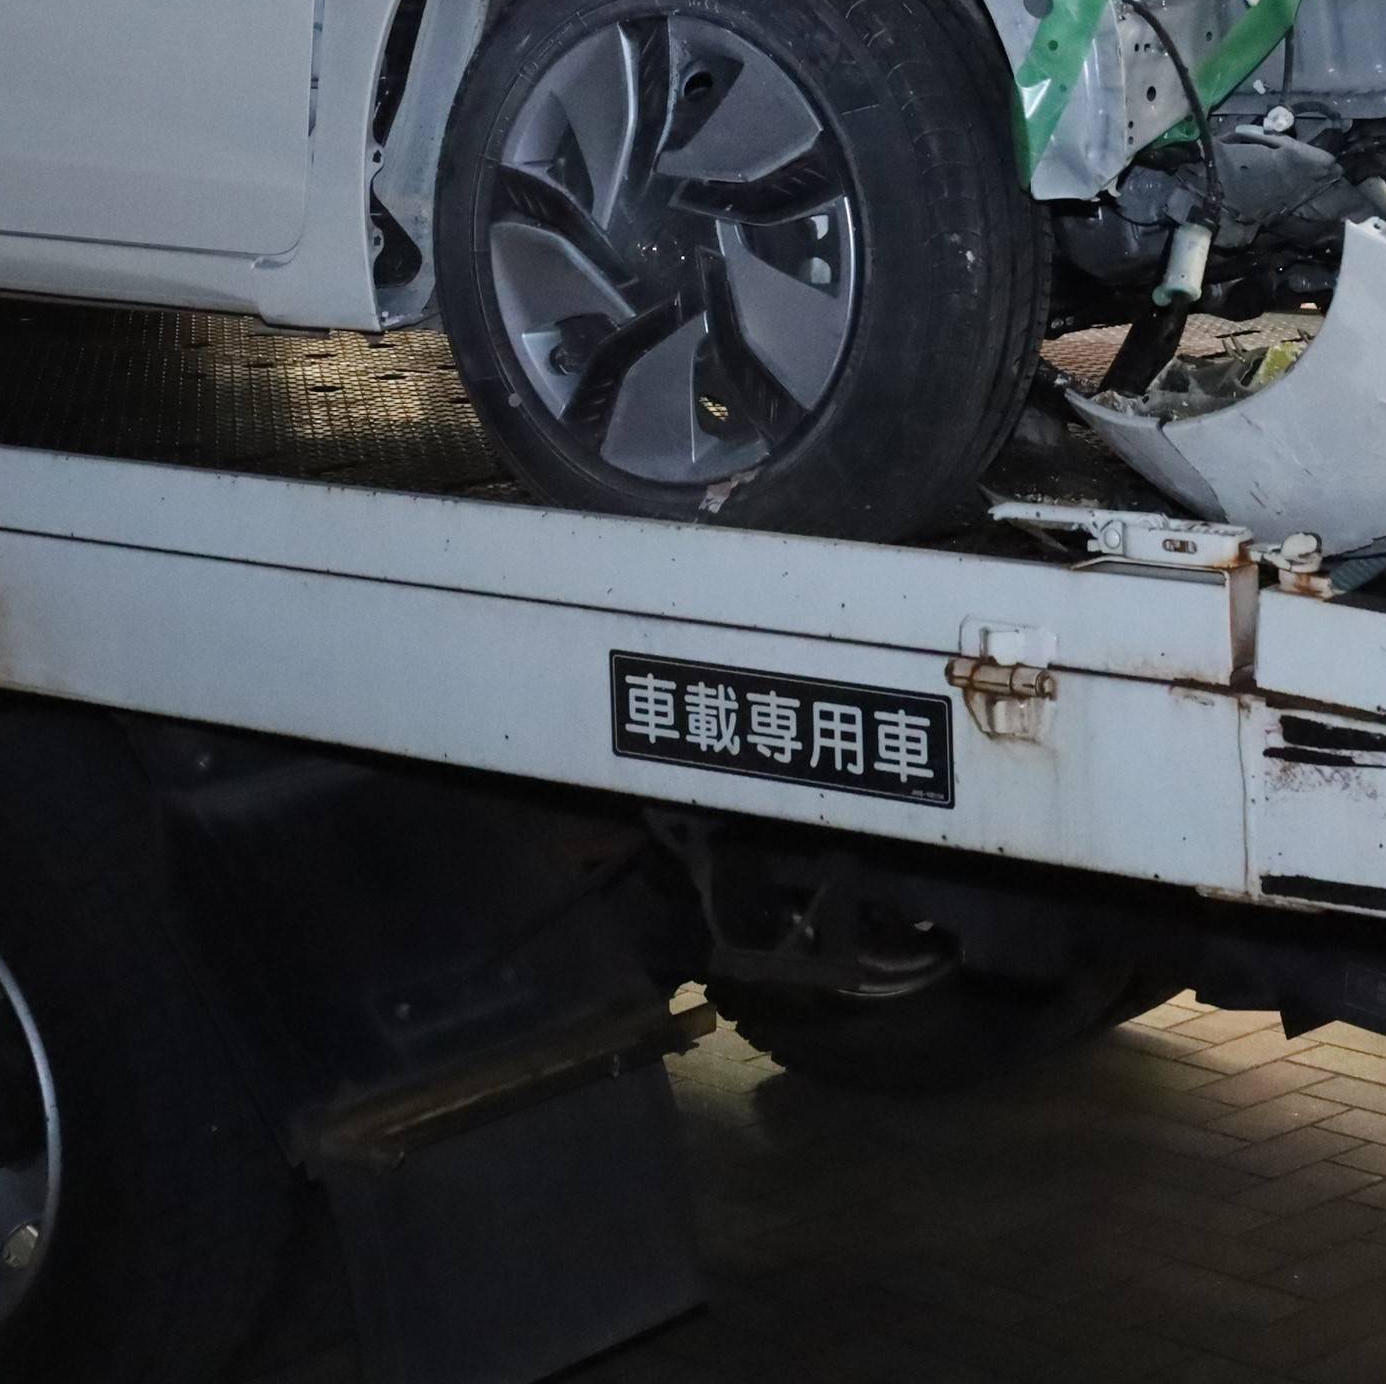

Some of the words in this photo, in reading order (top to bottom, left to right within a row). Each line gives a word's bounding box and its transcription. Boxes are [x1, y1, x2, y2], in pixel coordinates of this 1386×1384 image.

[624, 672, 935, 783] 車載専用車
